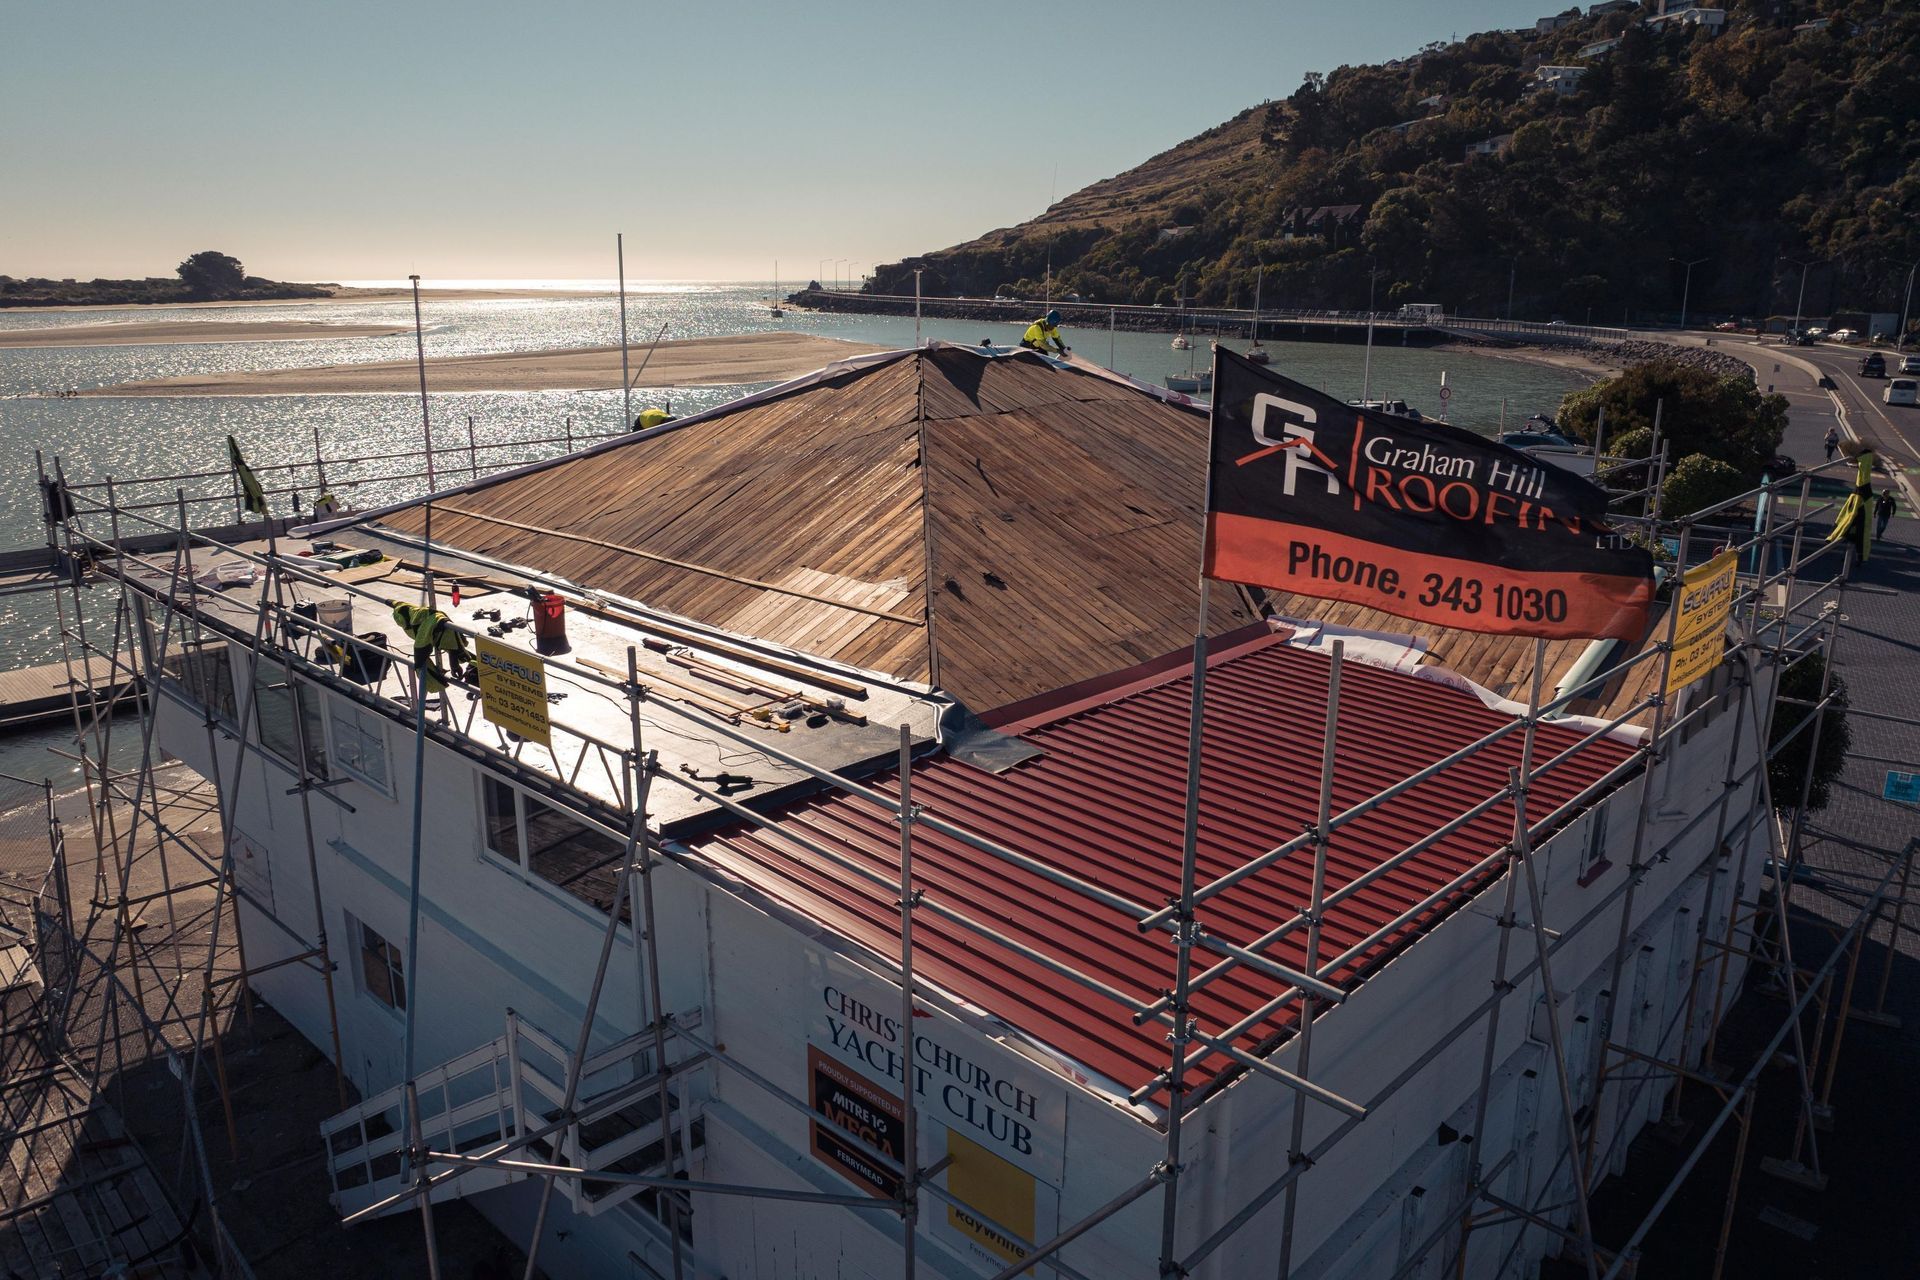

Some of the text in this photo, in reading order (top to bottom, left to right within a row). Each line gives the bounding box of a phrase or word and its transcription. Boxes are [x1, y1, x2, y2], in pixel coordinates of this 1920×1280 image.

[1364, 436, 1546, 499] Graham Hill
[1366, 465, 1612, 535] ROOFIN
[1596, 534, 1635, 550] LTD
[1289, 540, 1568, 623] Phone. 343 1030
[480, 651, 542, 685] SCAFFOLD
[496, 674, 545, 698] SYSTEMS
[494, 685, 536, 707] CANTERBURY
[498, 698, 509, 709] 03
[818, 1061, 902, 1117] PROUDLY SUPPORTED BY
[825, 1015, 1033, 1156] YACHT CLUB
[832, 1091, 887, 1133] MITRE 10
[837, 1150, 883, 1185] FERRYMEAD
